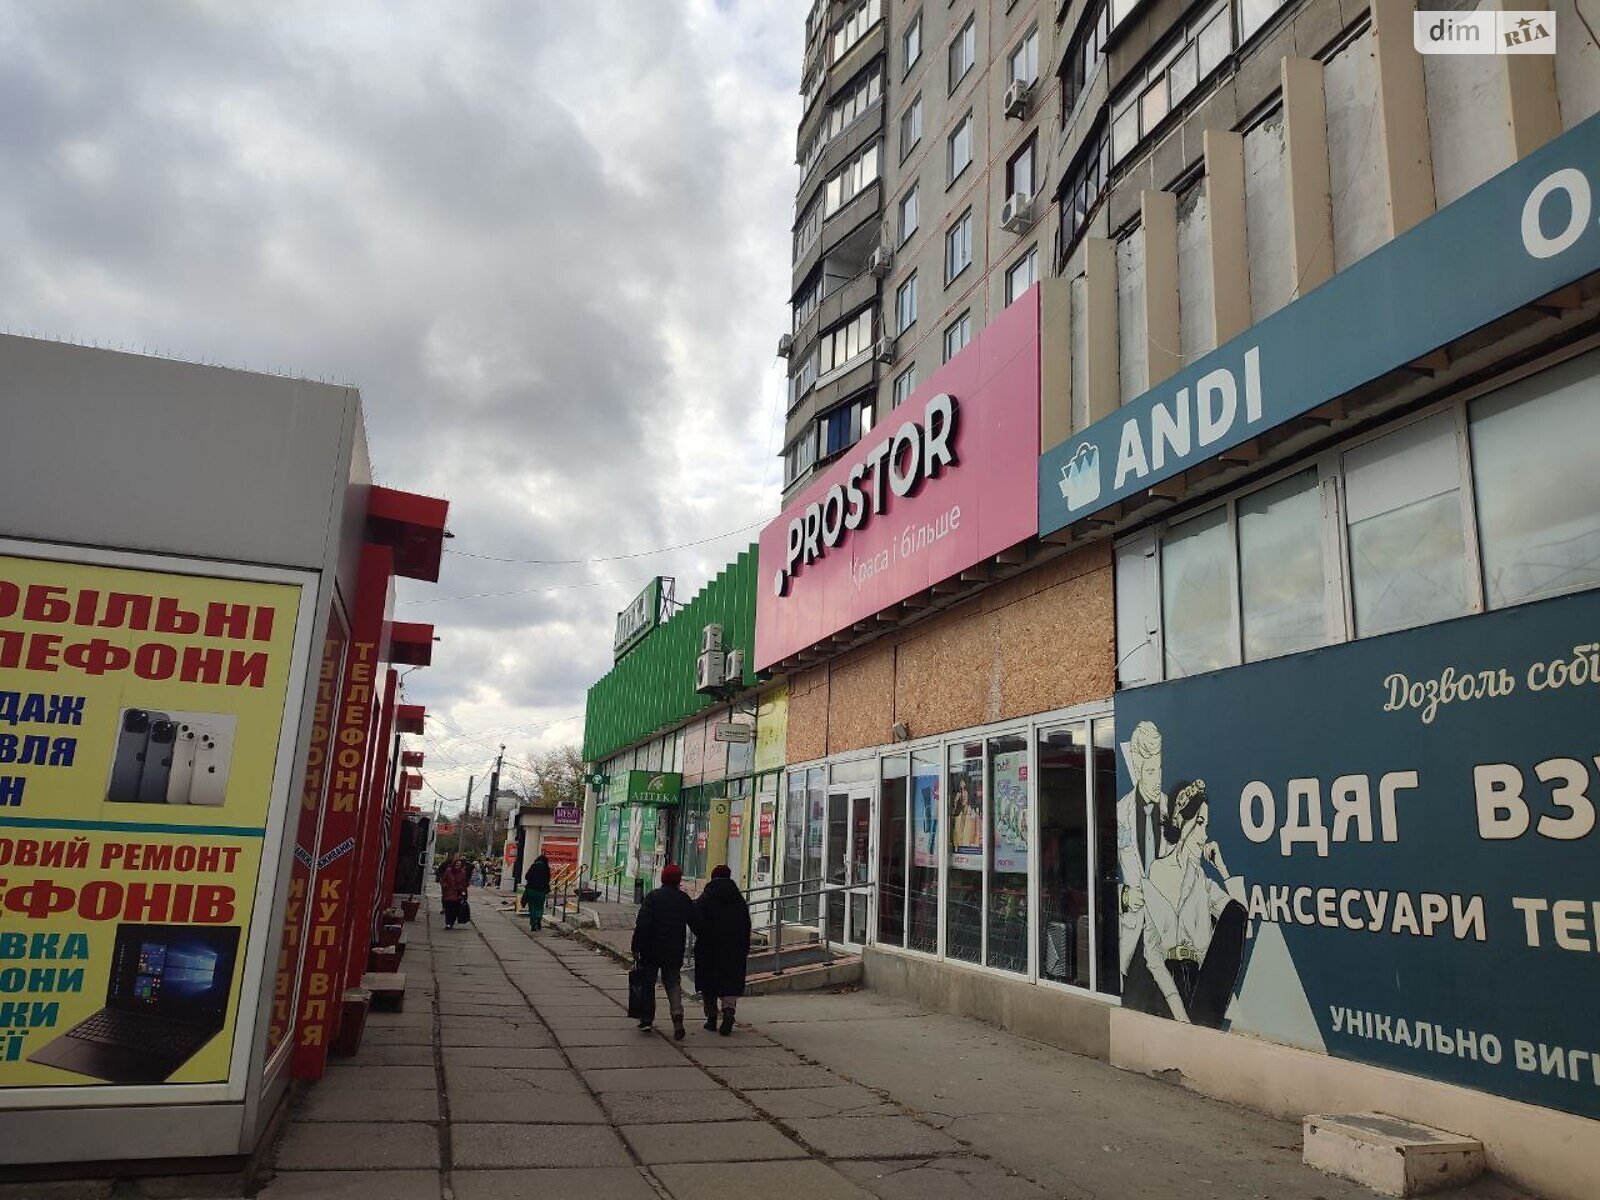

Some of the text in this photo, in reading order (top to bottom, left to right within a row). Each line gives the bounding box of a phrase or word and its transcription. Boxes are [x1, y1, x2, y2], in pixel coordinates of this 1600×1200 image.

[1113, 345, 1262, 490] ANDI
[849, 548, 889, 592] Краса
[901, 504, 960, 558] більше
[1383, 643, 1600, 724] Дозволь собі
[332, 642, 375, 813] ТЕЛЕФОНИ
[632, 792, 678, 802] АПТЕКА
[1239, 755, 1600, 857] ОДЯГ ВЗ
[100, 843, 242, 873] РЕМОНТ
[0, 878, 236, 923] ФОНІВ
[1249, 884, 1600, 952] АКСЕСУАРИ ТЕ
[0, 932, 89, 959] ВКА
[0, 968, 84, 992] ОНИ
[301, 879, 342, 1046] КУПІВЛЯ
[0, 1030, 29, 1061] Ї
[1330, 1005, 1600, 1086] УНІКАЛЬНО ВИГ
